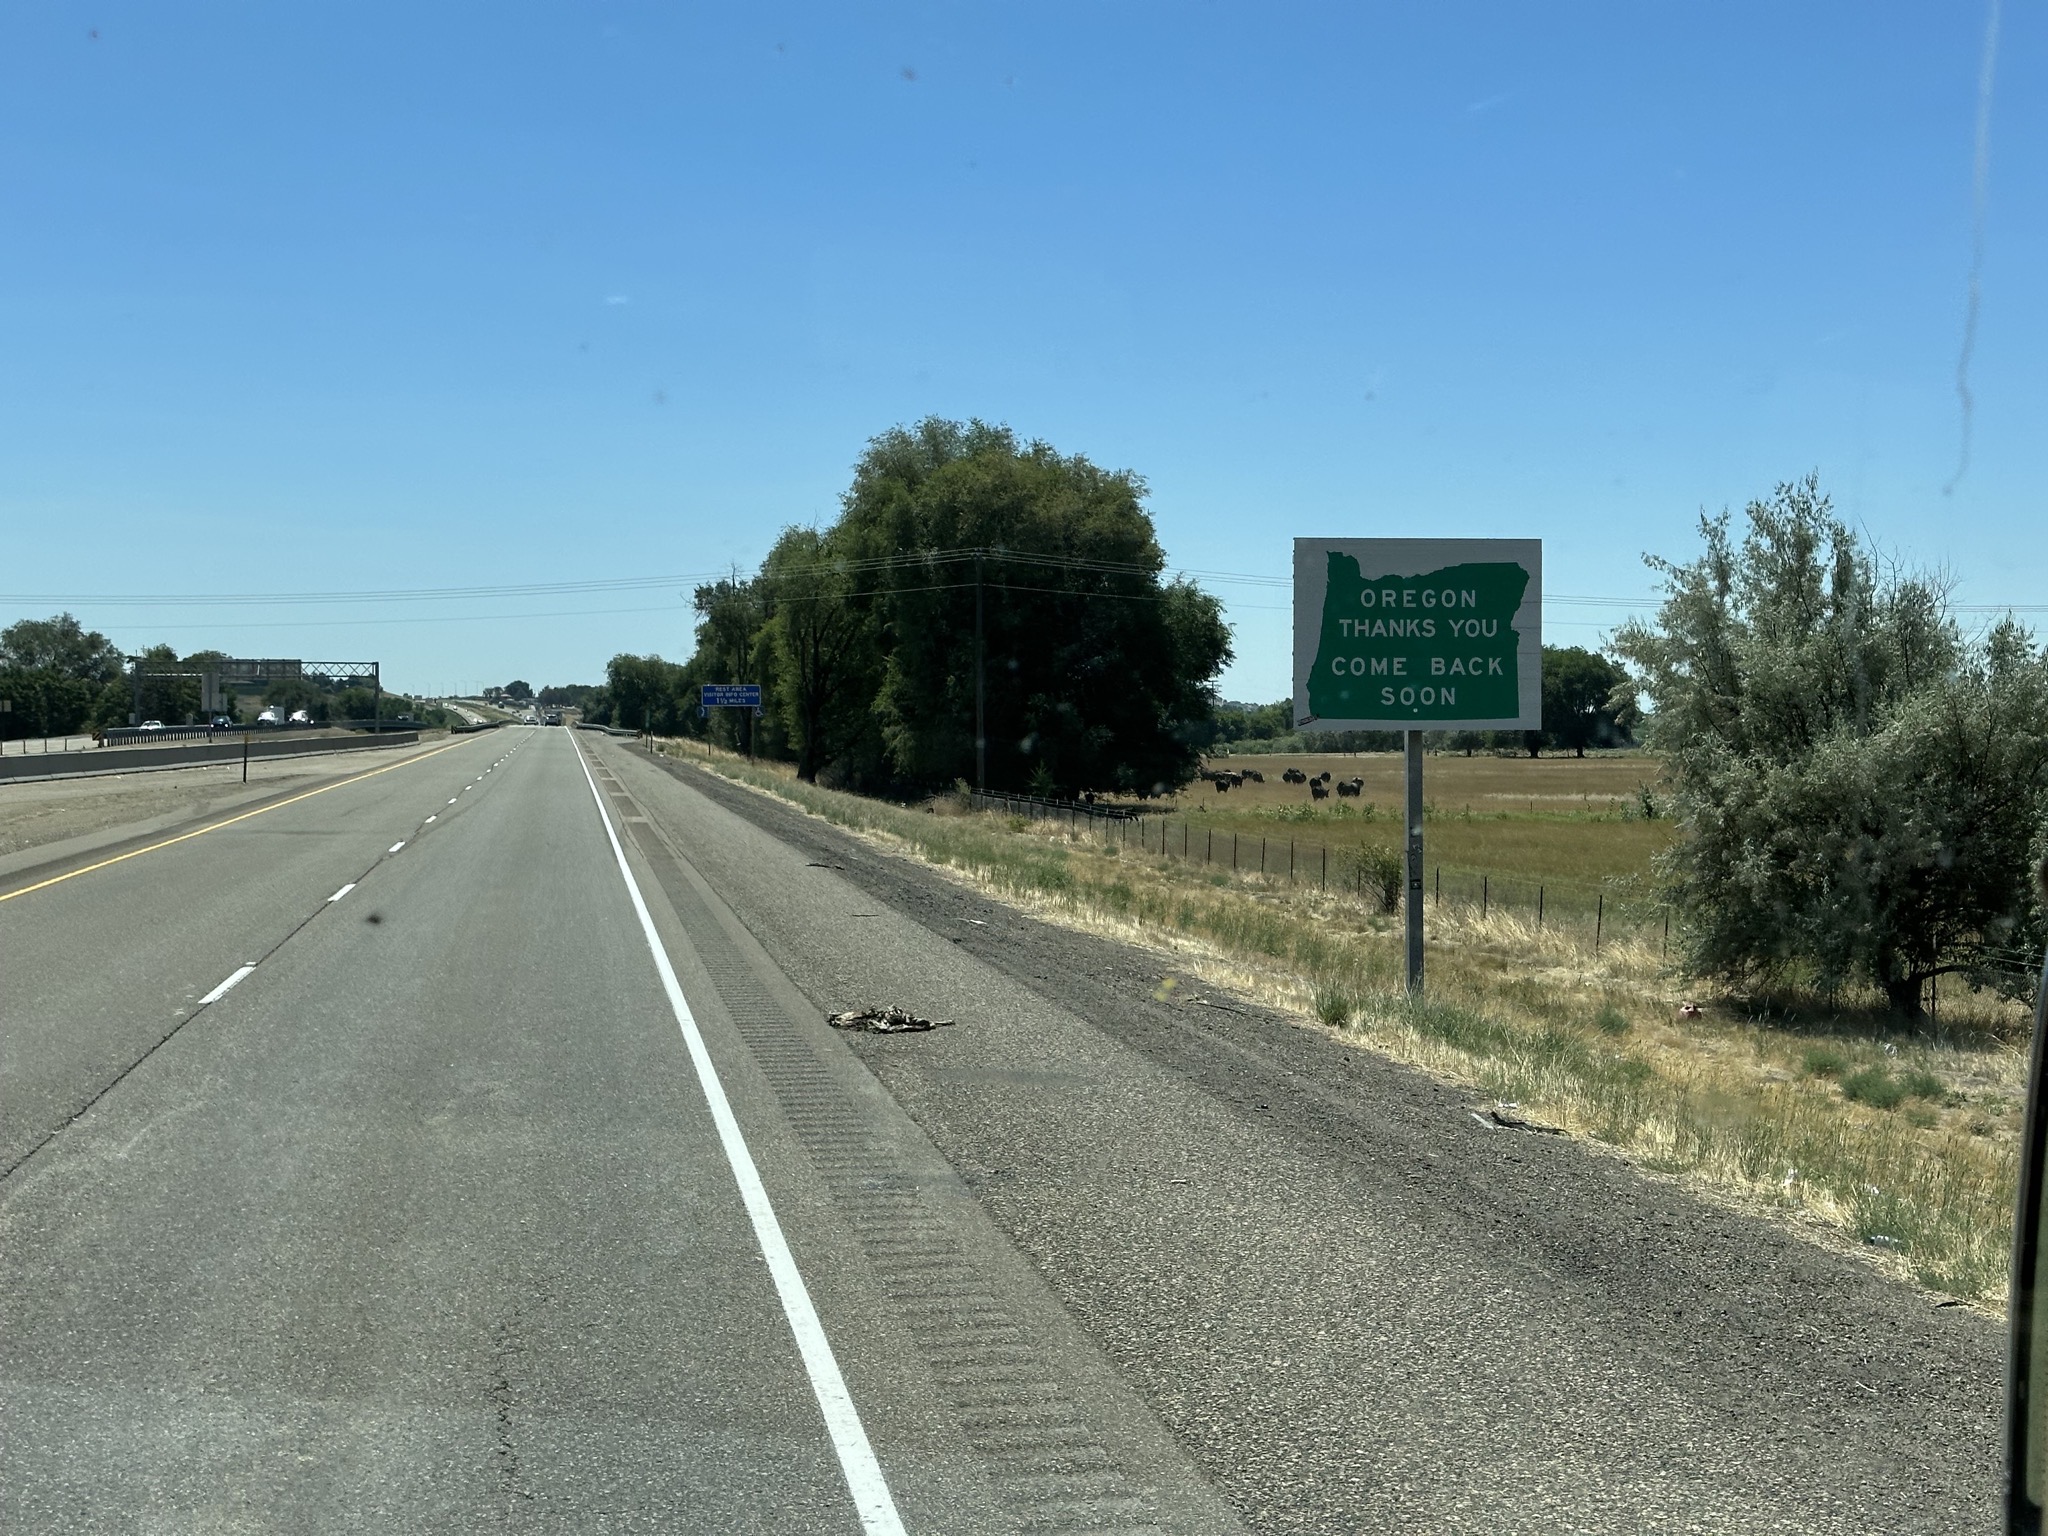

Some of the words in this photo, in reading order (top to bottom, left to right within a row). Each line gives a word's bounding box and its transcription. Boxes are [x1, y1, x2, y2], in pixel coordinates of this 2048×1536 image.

[1361, 589, 1476, 608] OREGON
[1339, 619, 1436, 638] THANKS
[1448, 619, 1498, 638] YOU
[1332, 657, 1407, 676] COME
[1431, 657, 1504, 676] BACK
[1381, 687, 1456, 706] SOON
